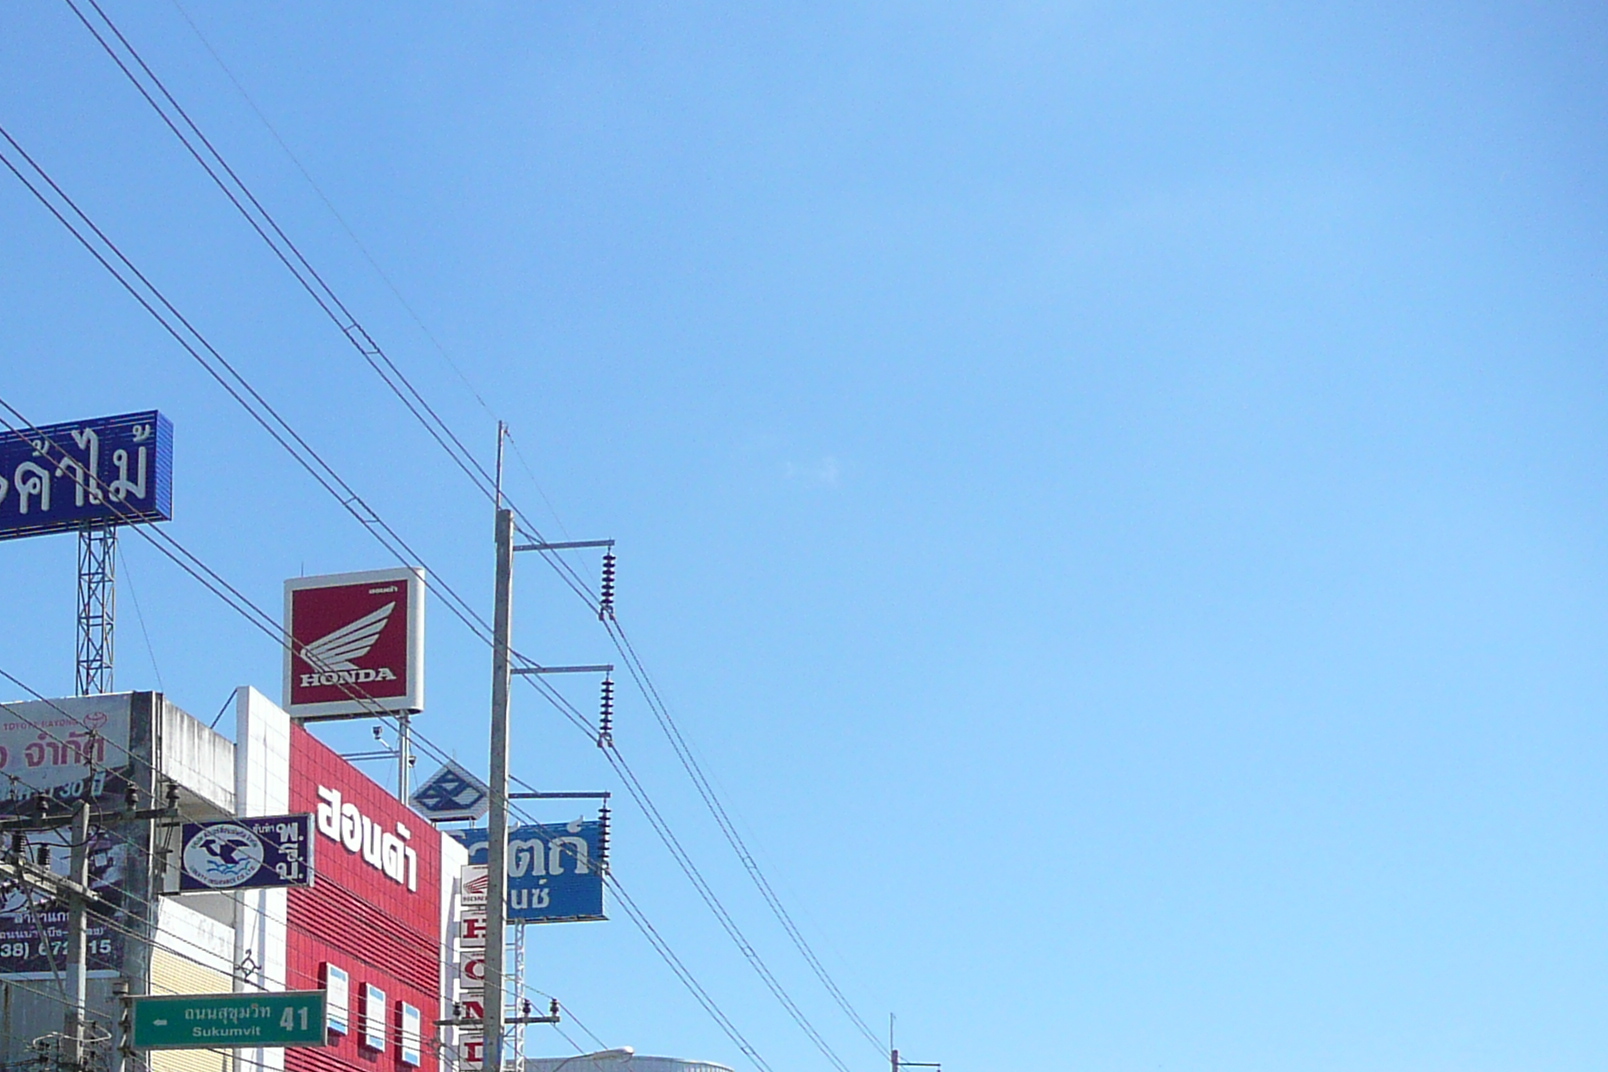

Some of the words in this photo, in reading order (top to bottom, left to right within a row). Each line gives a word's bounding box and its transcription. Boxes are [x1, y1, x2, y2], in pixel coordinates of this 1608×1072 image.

[300, 668, 397, 687] HONDA
[25, 731, 105, 768] จำกัด
[59, 780, 83, 798] 30
[317, 784, 417, 893] ฮอนด้า
[185, 1003, 271, 1025] ถนนสุขุมวิท
[279, 1006, 308, 1031] 41
[192, 1026, 261, 1037] Sukumvit
